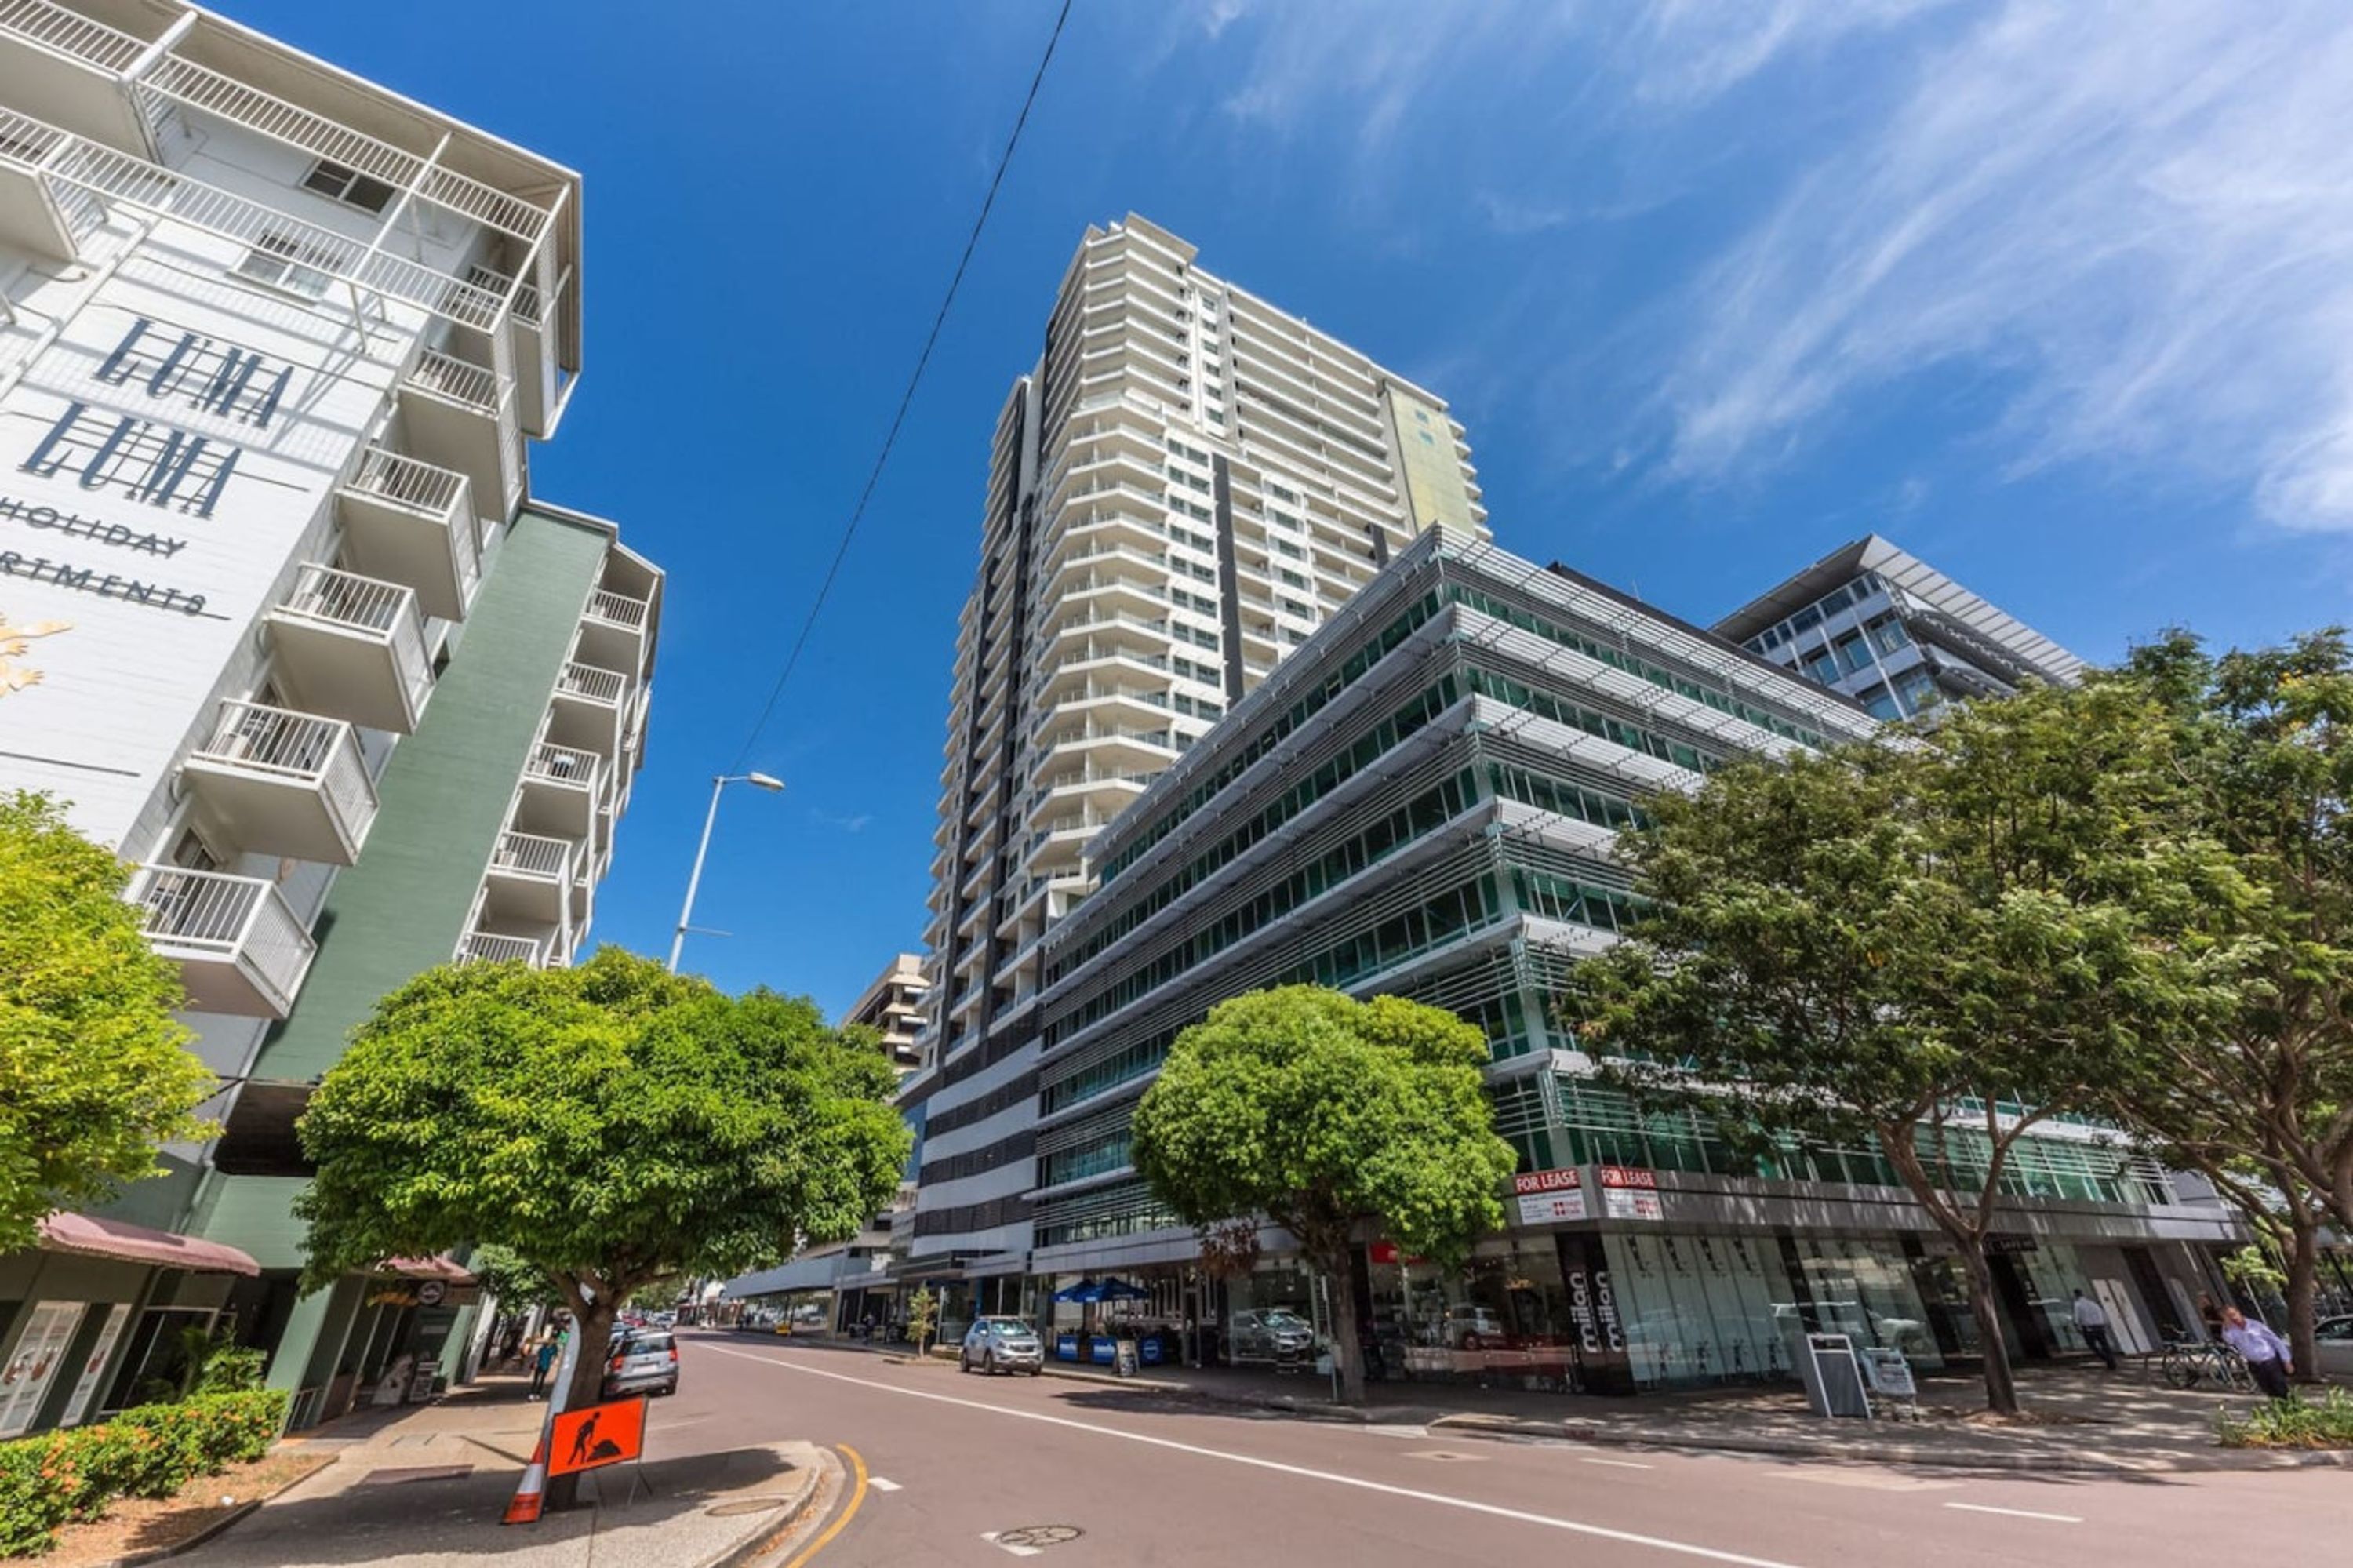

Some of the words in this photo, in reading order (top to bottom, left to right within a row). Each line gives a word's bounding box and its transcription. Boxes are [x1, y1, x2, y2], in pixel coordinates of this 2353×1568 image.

[91, 316, 295, 429] LUMA
[16, 401, 242, 519] LUMA
[0, 497, 187, 559] HOLIDAY
[1516, 1177, 1540, 1192] FOR
[1541, 1170, 1578, 1188] LEASE
[1601, 1169, 1623, 1185] FOR
[1623, 1170, 1655, 1187] LEASE
